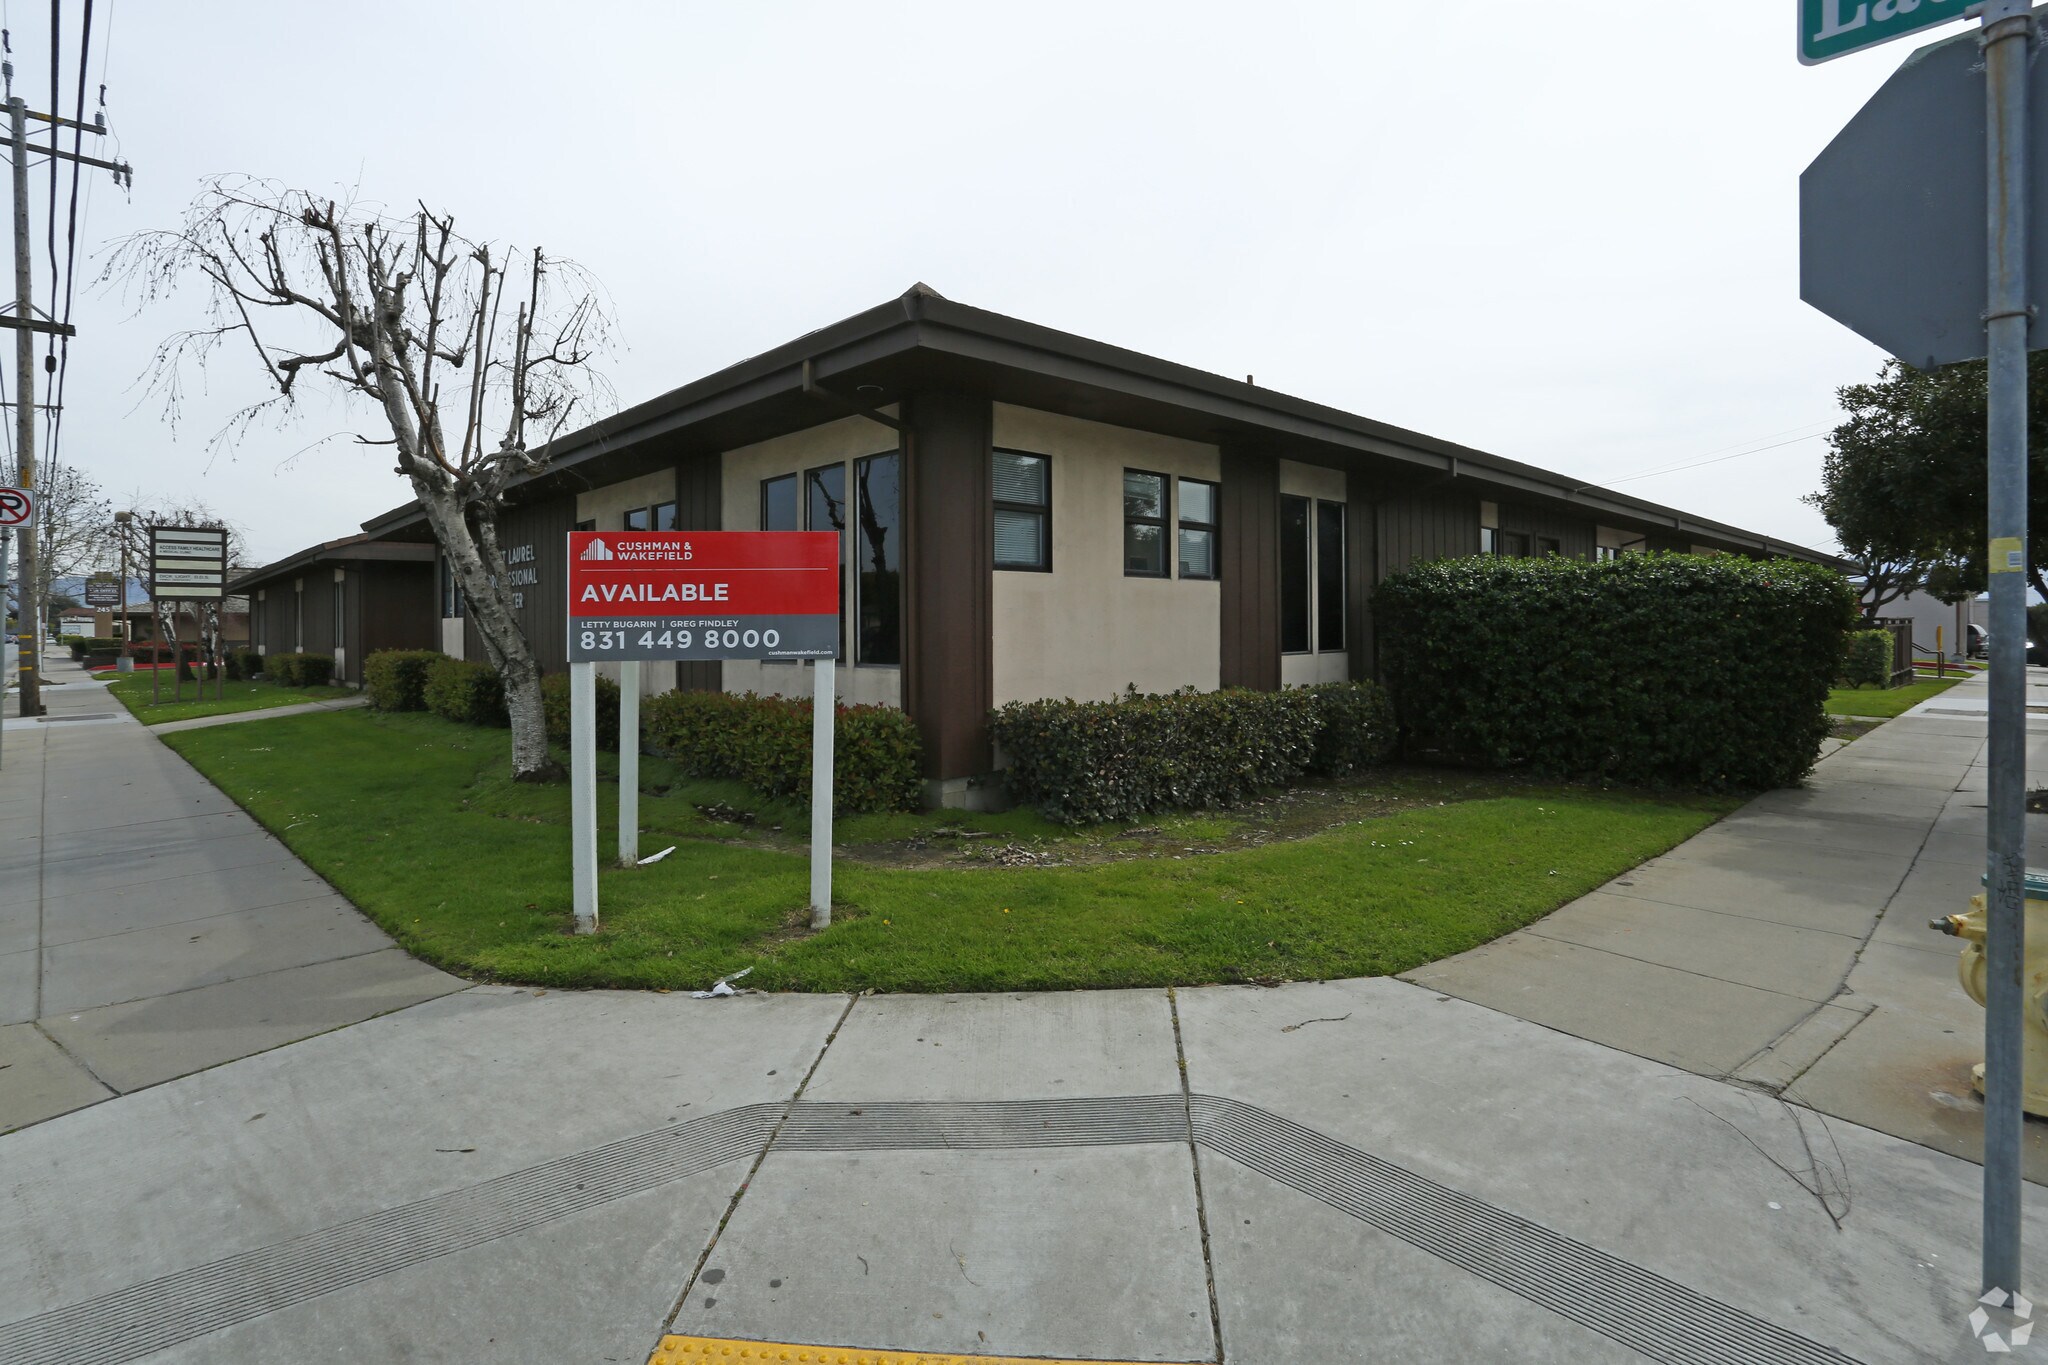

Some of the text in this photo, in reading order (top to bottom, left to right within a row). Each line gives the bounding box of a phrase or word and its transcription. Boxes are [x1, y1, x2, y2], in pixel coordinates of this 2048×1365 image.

[1813, 0, 1948, 43] La
[508, 544, 535, 564] LAUREL
[617, 541, 692, 551] CUSHMAN &
[617, 551, 693, 561] WAKEFIELD
[581, 584, 729, 602] AVAILABLE
[613, 620, 657, 628] BUGARIN
[670, 620, 696, 628] GREG
[699, 619, 739, 628] FINDLEY
[580, 629, 780, 649] 831 449 8000
